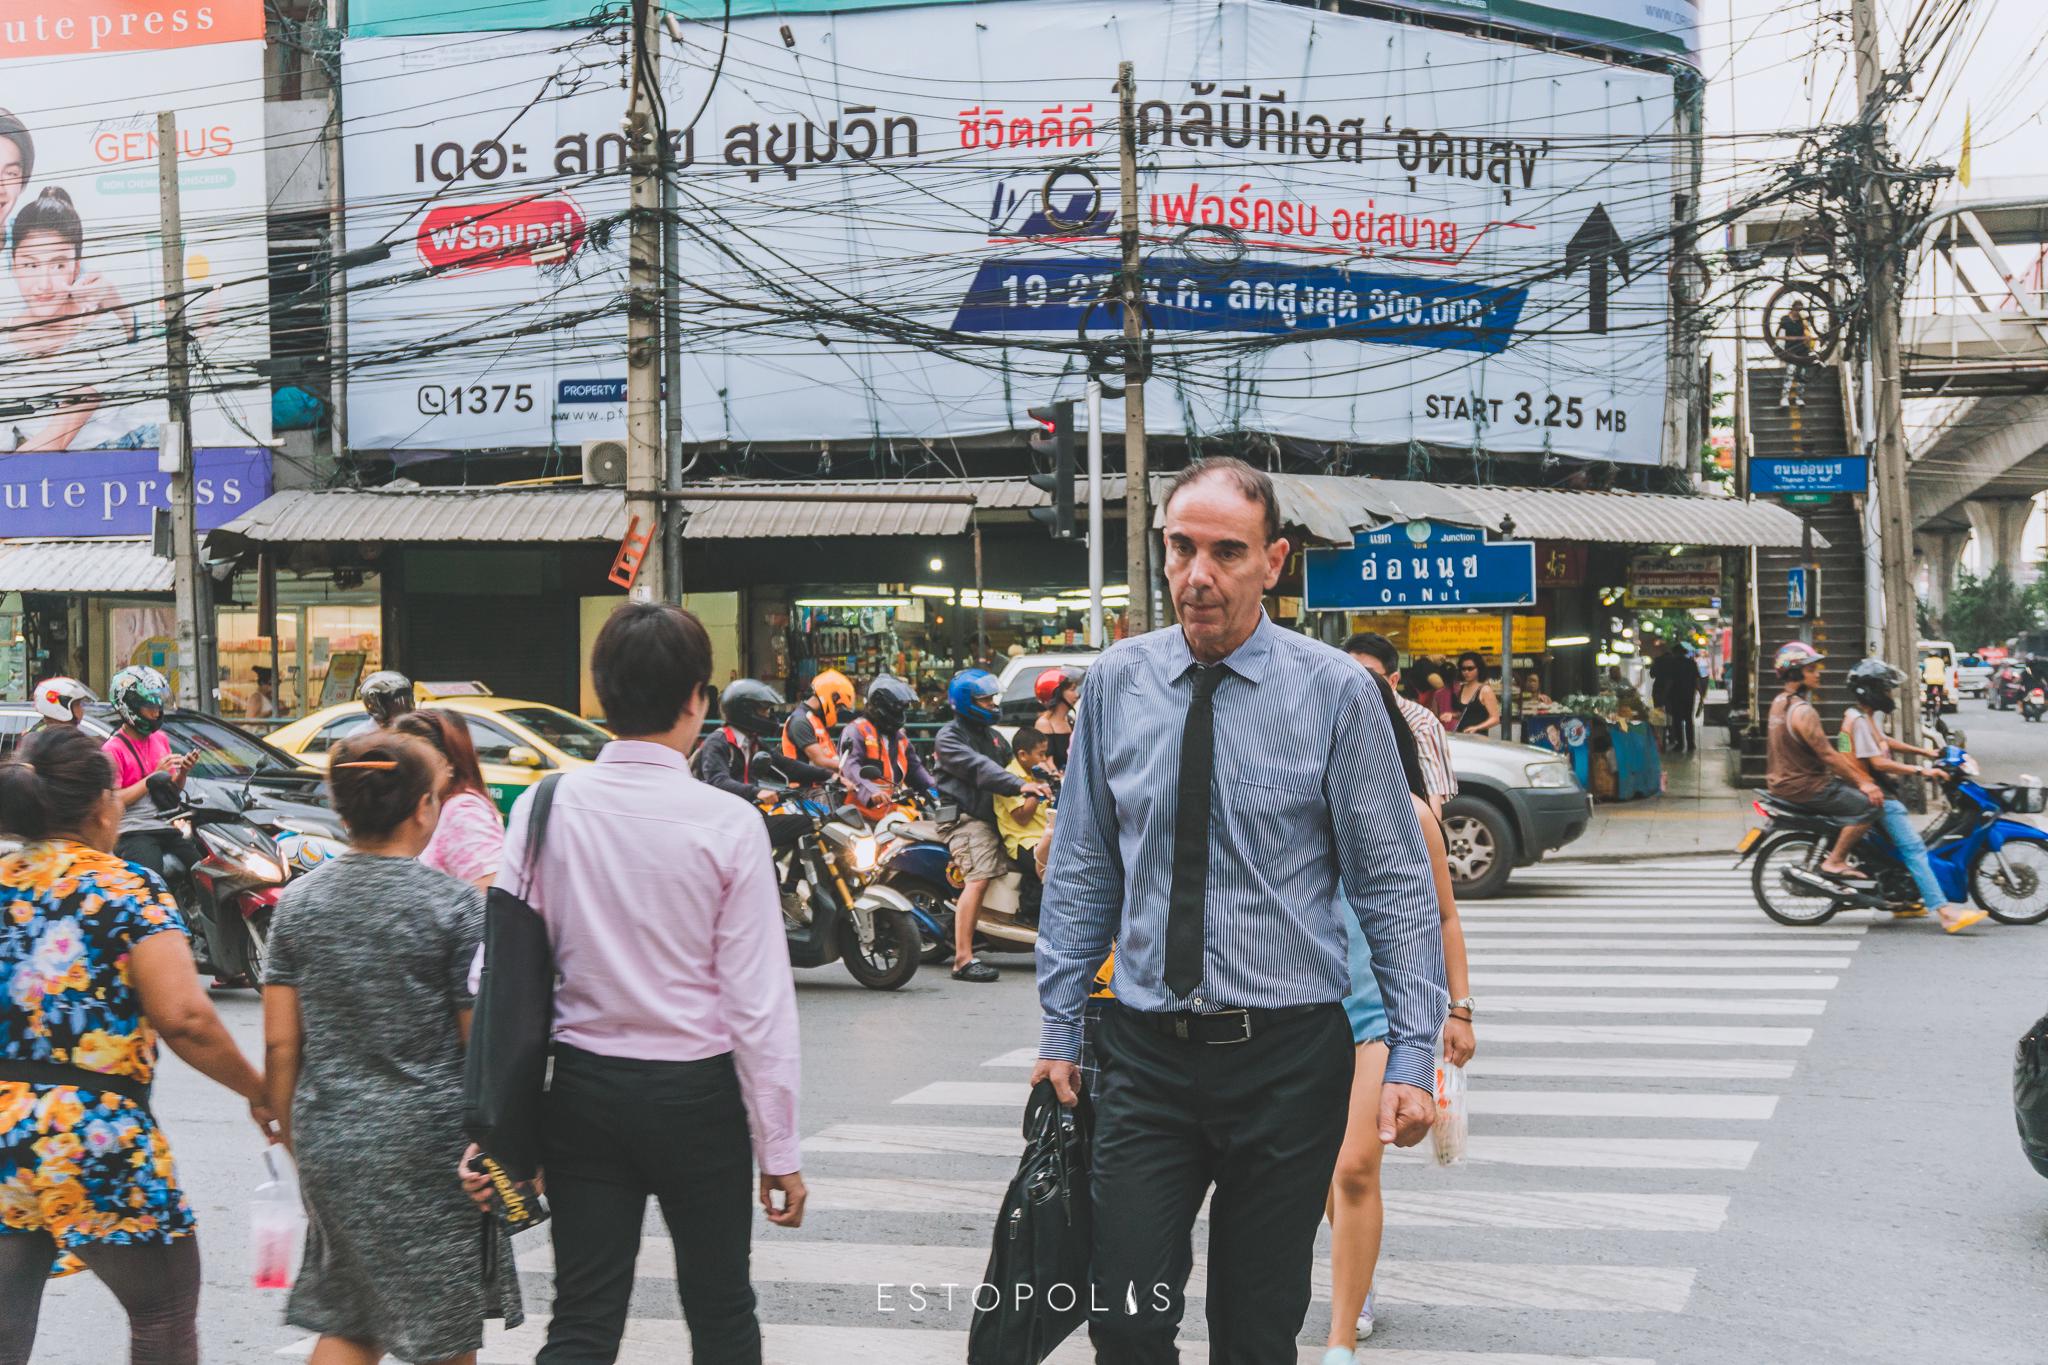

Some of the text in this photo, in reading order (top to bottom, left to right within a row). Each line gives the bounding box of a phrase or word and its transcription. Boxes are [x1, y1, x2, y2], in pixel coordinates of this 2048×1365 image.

[89, 7, 214, 49] press
[414, 139, 527, 182] เดอะ
[723, 105, 918, 183] สุขุมวิท
[958, 102, 1094, 150] ชีวิตดีดี
[1150, 182, 1457, 259] เฟอร์ครบ อยู่สบาย
[1228, 279, 1358, 329] ลดสูงสุด
[450, 384, 533, 414] 1375
[563, 384, 616, 397] PROPERTY
[1426, 391, 1627, 432] START 3.25 MB
[1369, 534, 1392, 545] แยก
[1440, 532, 1475, 543] Junction
[1361, 552, 1478, 588] อ่อนนุช
[1380, 587, 1460, 603] On Nut
